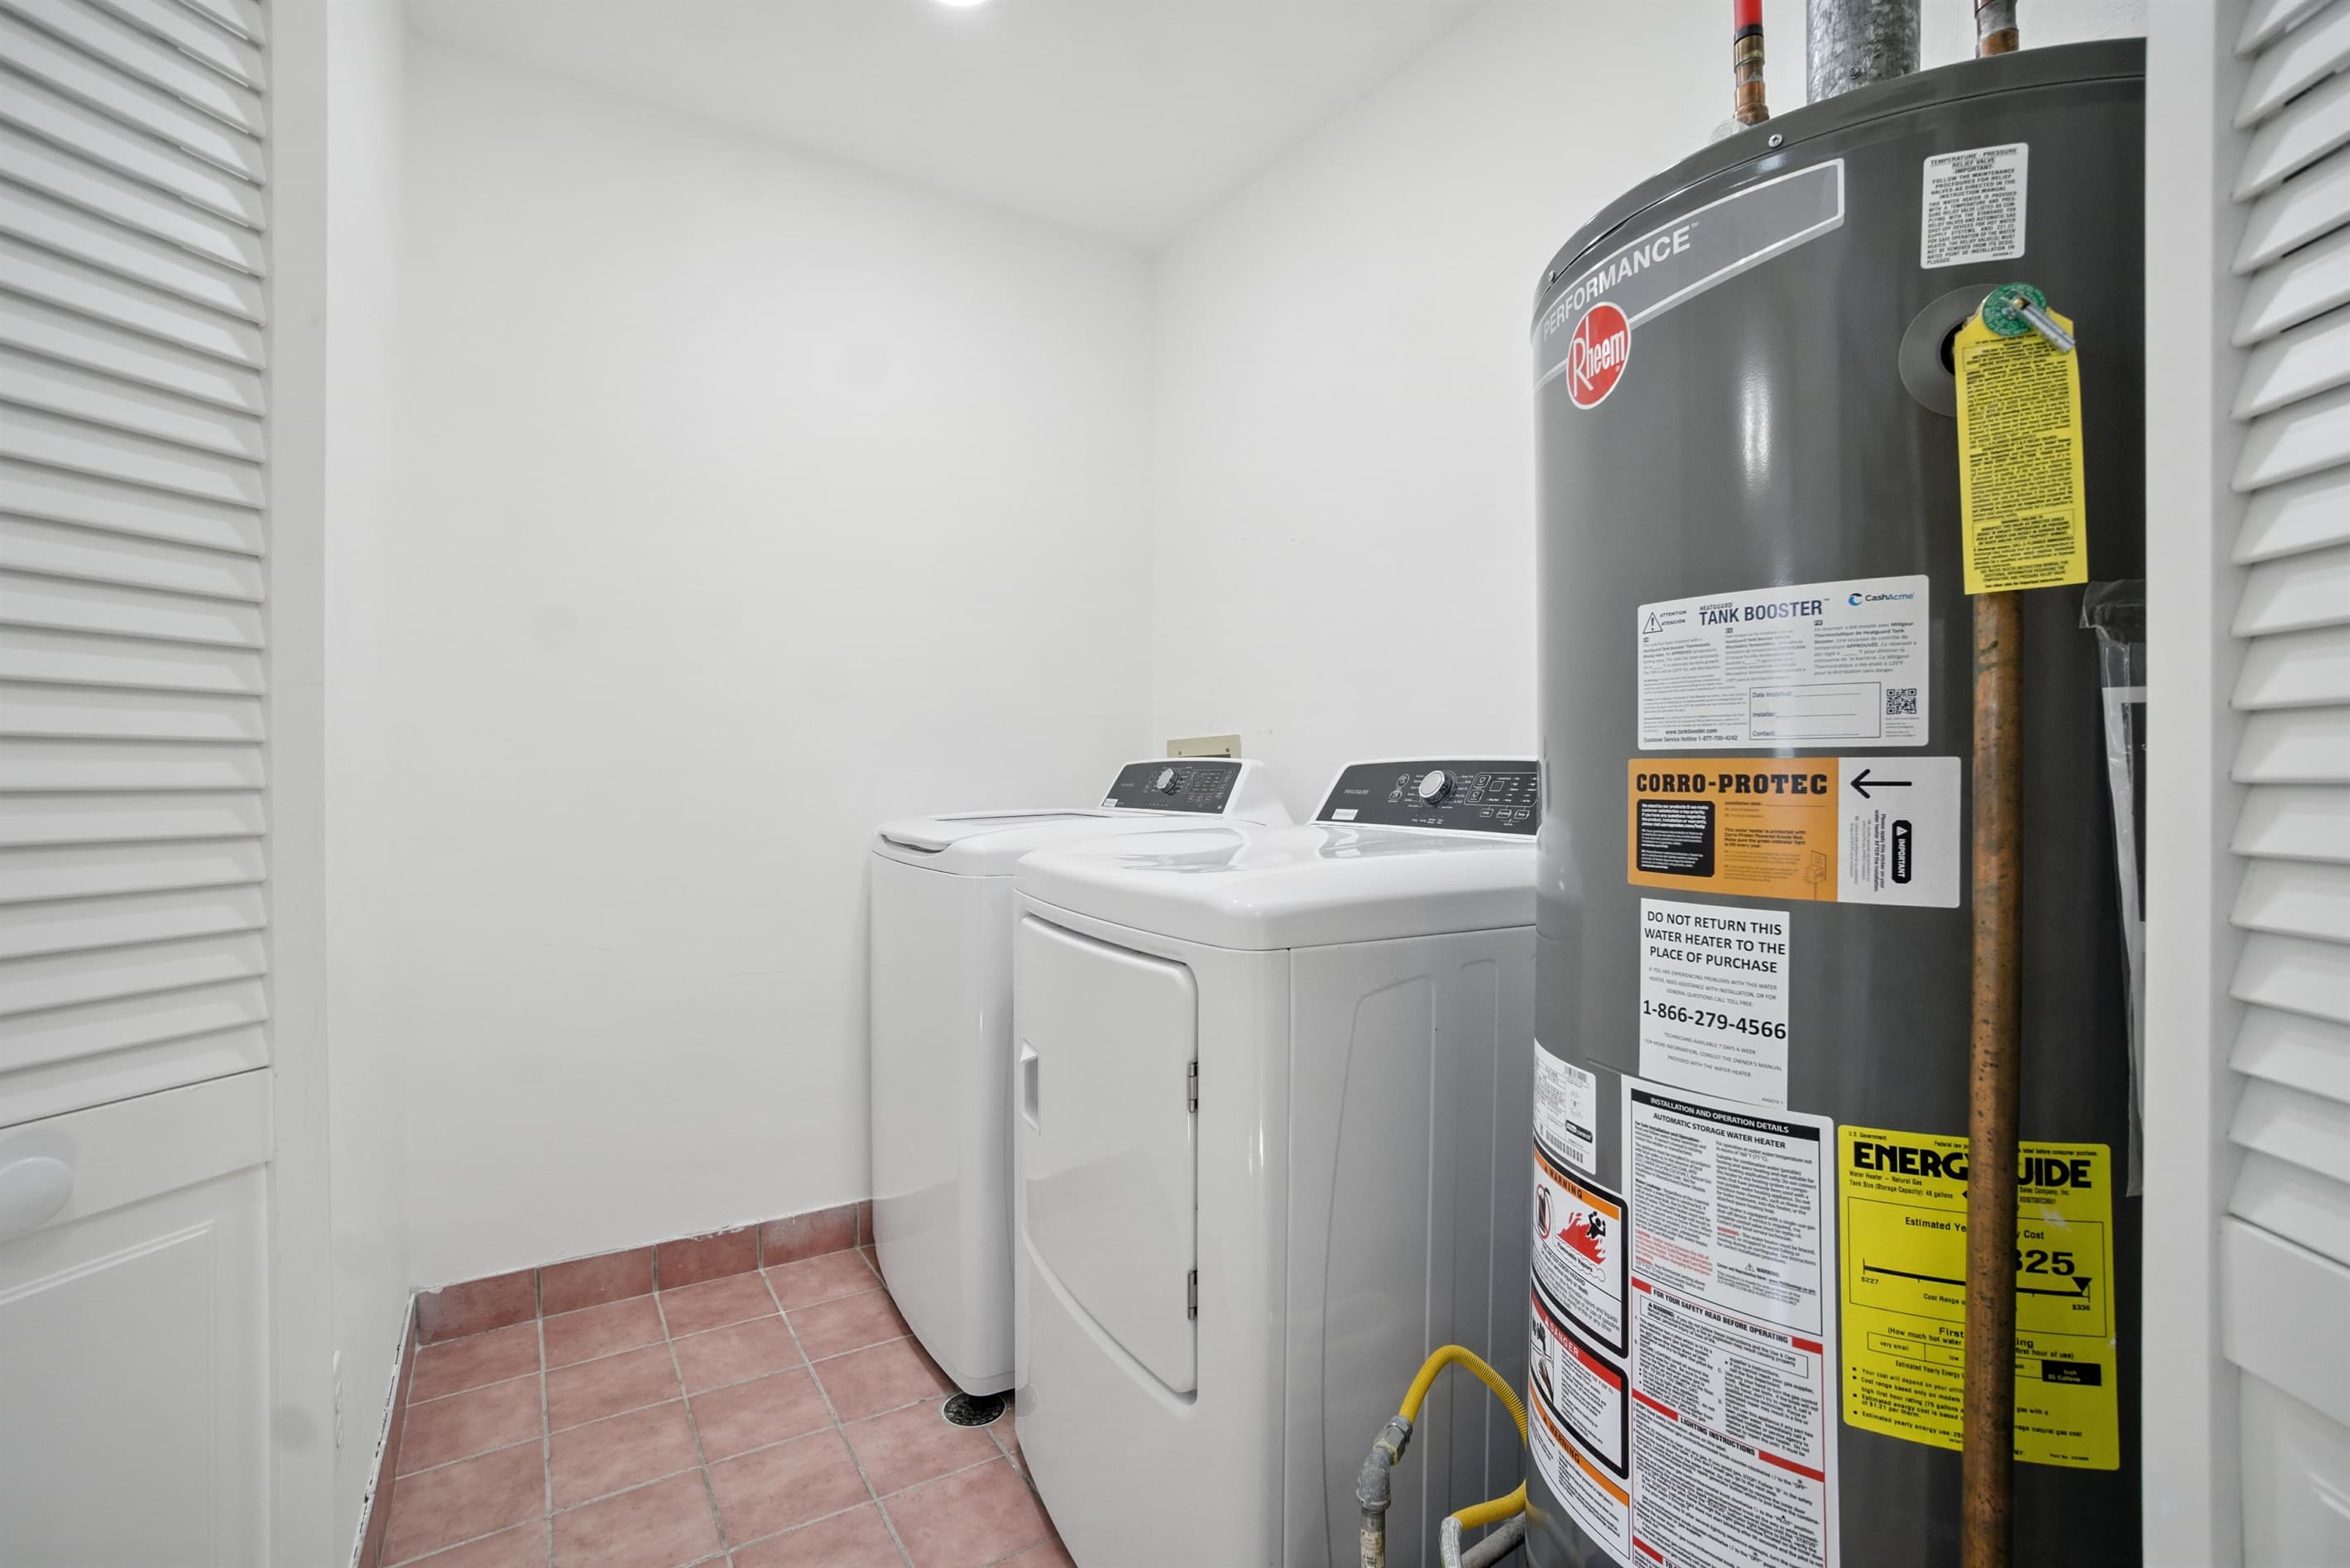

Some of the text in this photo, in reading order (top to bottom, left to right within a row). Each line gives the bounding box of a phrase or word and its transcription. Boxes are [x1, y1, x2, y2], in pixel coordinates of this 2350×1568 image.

[1930, 148, 2017, 165] TEMPERATURE PRESSURE
[1544, 225, 1691, 343] PERFORMANCE
[1573, 315, 1625, 397] Rheem
[1700, 602, 1733, 611] HEATGUARD
[1865, 593, 1914, 602] CashAcme
[1700, 600, 1822, 626] TANK BOOSTER
[1637, 774, 1828, 794] CORRO-PROTEC
[1897, 838, 1906, 877] IMPORTANT
[1647, 911, 1782, 935] DO NOT RETURN THIS
[1644, 928, 1786, 955] WATER HEATER TO THE
[1650, 946, 1777, 973] PLACE OF PURCHASE
[1671, 971, 1703, 980] EXPERIENCING
[1705, 975, 1729, 985] PROBLEMS
[1643, 1000, 1786, 1039] 1-866-279-4566
[1664, 1032, 1692, 1043] TECHNICIANS
[1650, 1097, 1789, 1134] INSTALLATION AND OPERATION DETAILS
[1653, 1113, 1786, 1148] AUTOMATIC STORAGE WATER HEATER
[1859, 1132, 1887, 1141] Government
[1550, 1168, 1583, 1200] WARNING
[1865, 1172, 1882, 1181] Heater
[1892, 1176, 1911, 1184] Natural
[1875, 1183, 1897, 1192] (Storage
[1905, 1216, 1950, 1230] Estimated
[2024, 1230, 2044, 1240] Cost
[1862, 1277, 1878, 1285] $227
[1923, 1292, 1959, 1305] Cost Range
[1653, 1289, 1788, 1344] FOR YOUR SAFETY READ BEFORE OPERATING
[1549, 1322, 1579, 1357] DANGER
[1887, 1327, 1905, 1335] (How
[1908, 1331, 1926, 1340] much
[1929, 1334, 1940, 1342] hot
[1939, 1327, 1964, 1338] First
[1880, 1341, 1892, 1350] very
[1862, 1368, 1875, 1376] Your
[1902, 1377, 1924, 1387] depend
[1896, 1360, 1960, 1379] Estimated Yearly Energy
[1549, 1422, 1580, 1464] WARNING
[1681, 1417, 1755, 1456] LIGHTING INSTRUCTIONS
